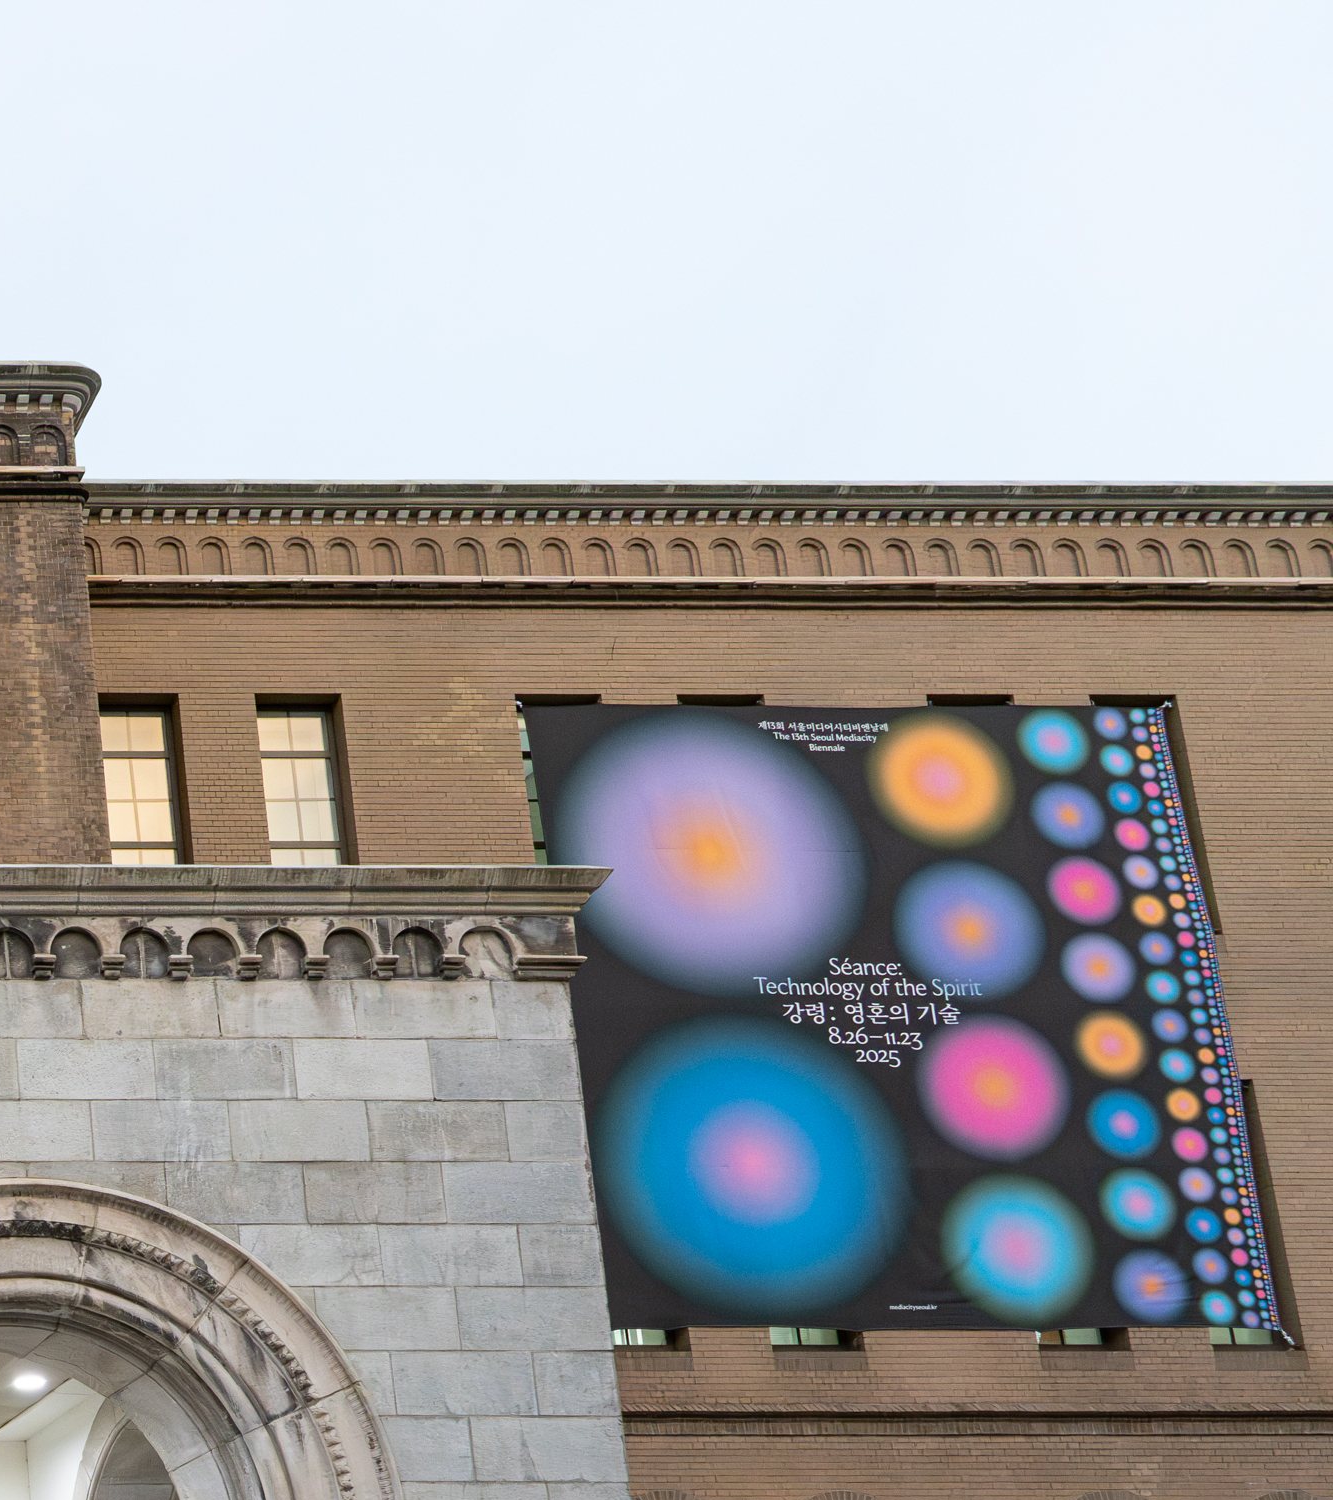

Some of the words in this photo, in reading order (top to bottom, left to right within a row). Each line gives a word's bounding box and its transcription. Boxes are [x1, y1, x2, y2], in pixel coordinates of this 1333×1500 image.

[758, 721, 784, 730] 제13회
[788, 722, 889, 732] 서울미디어시티비엔날레
[773, 732, 790, 740] The
[810, 733, 834, 741] Seoul
[836, 733, 877, 743] Mediacity
[809, 743, 845, 751] Biennale
[828, 958, 902, 975] Séance:
[753, 976, 864, 1000] Technology
[870, 978, 890, 996] of
[894, 978, 927, 996] the
[932, 979, 982, 1001] Spirit
[844, 1003, 909, 1025] 영혼의
[916, 1003, 961, 1025] 기술
[856, 1050, 901, 1068] 2025
